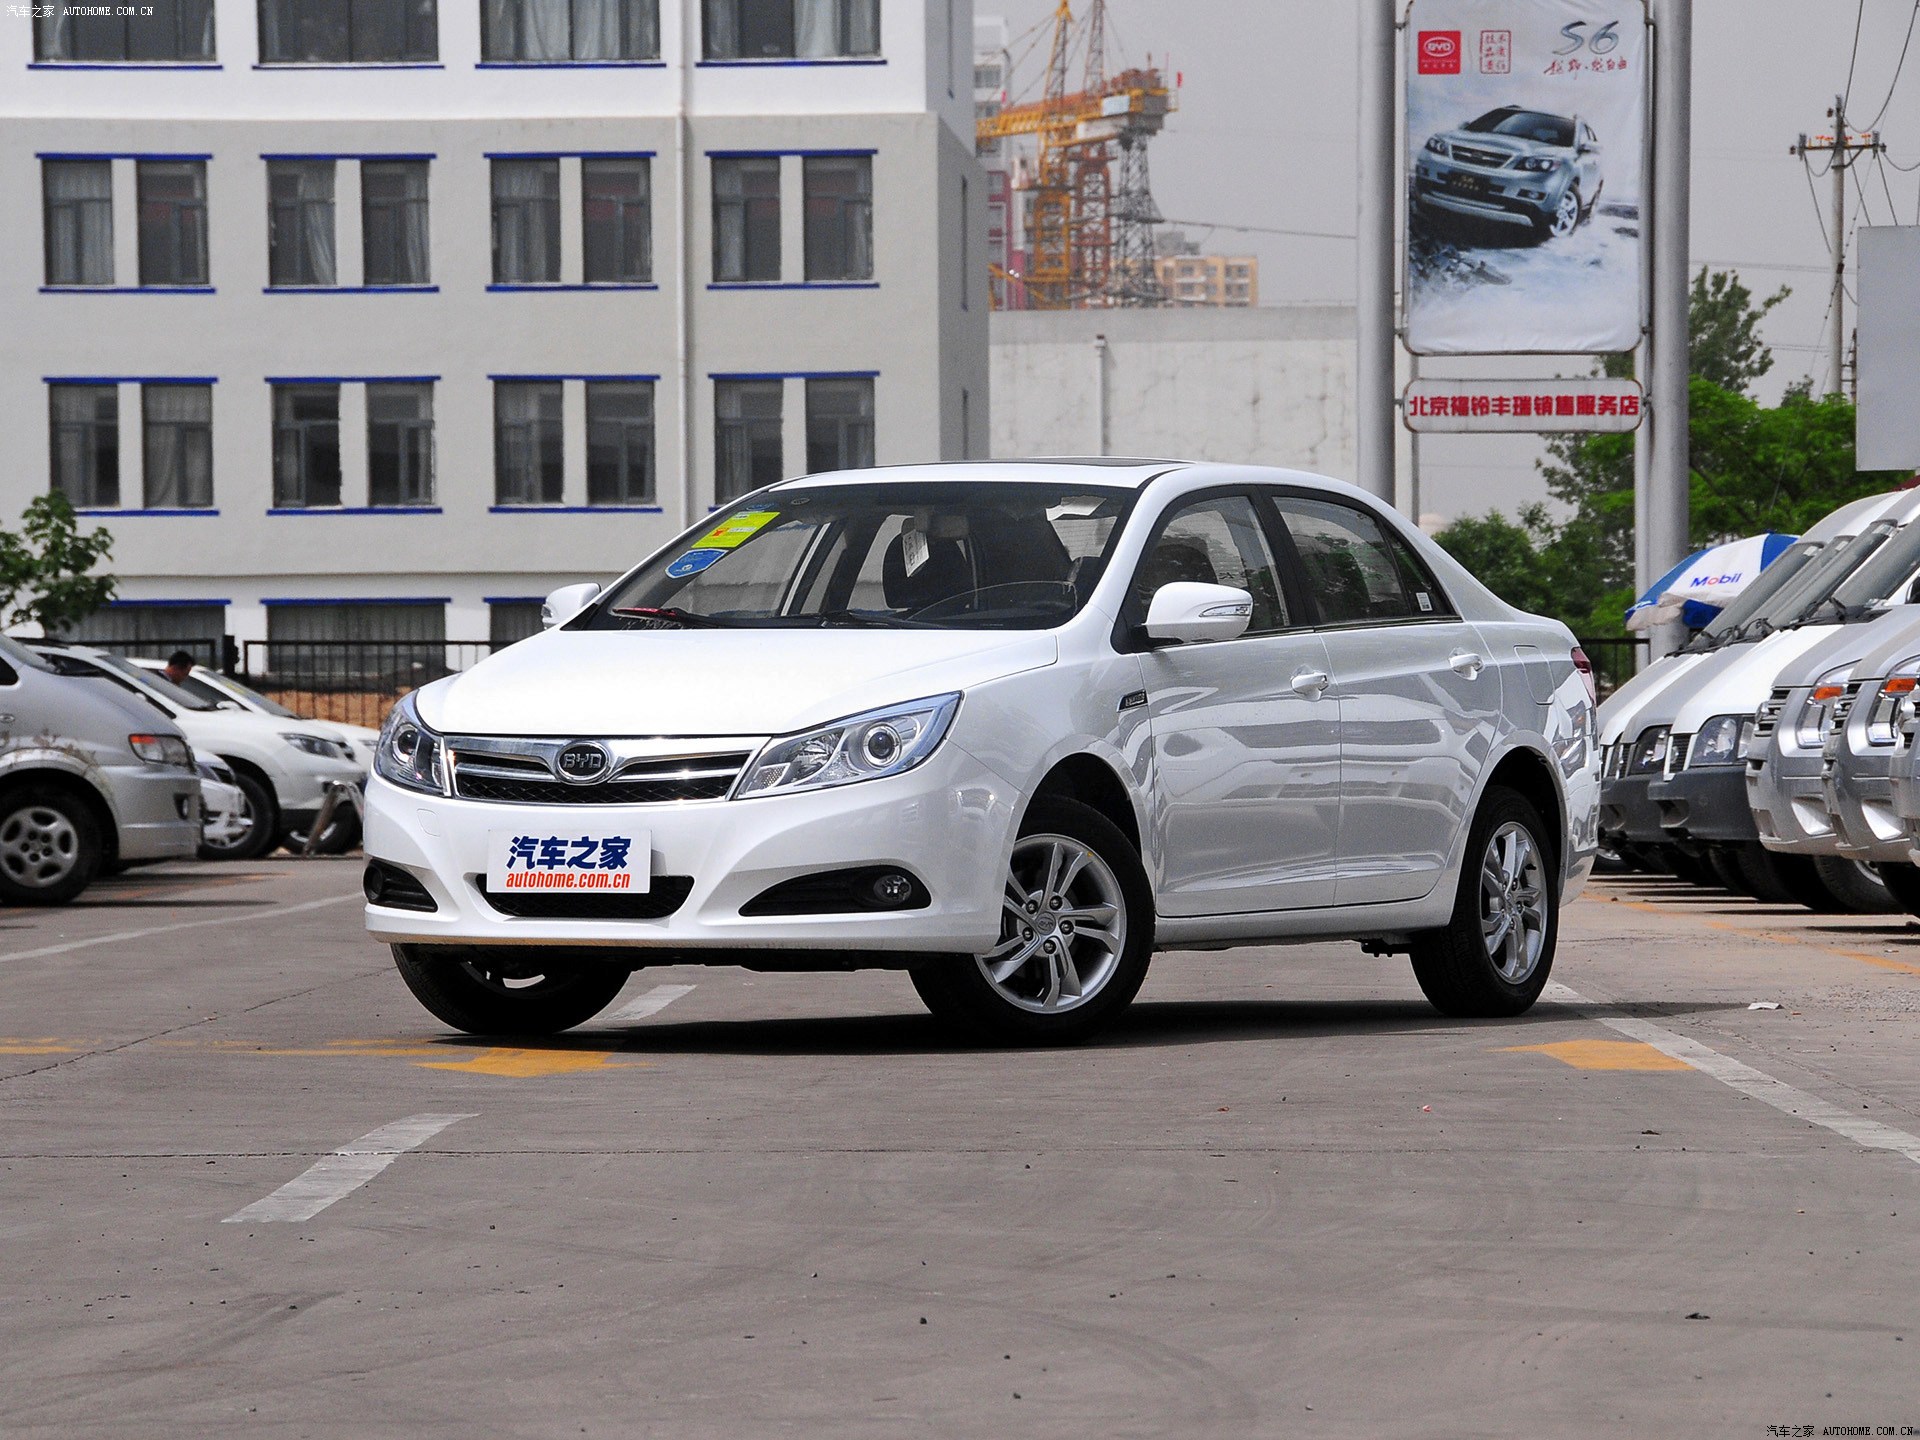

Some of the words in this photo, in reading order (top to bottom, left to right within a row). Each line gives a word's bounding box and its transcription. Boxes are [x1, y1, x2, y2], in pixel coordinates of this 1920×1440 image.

[1552, 21, 1619, 55] S6
[1427, 42, 1453, 53] BYD
[1690, 573, 1742, 587] Mobil
[563, 753, 602, 768] BYD
[506, 836, 631, 870] 汽车之家
[506, 872, 631, 888] autohome.com.cn
